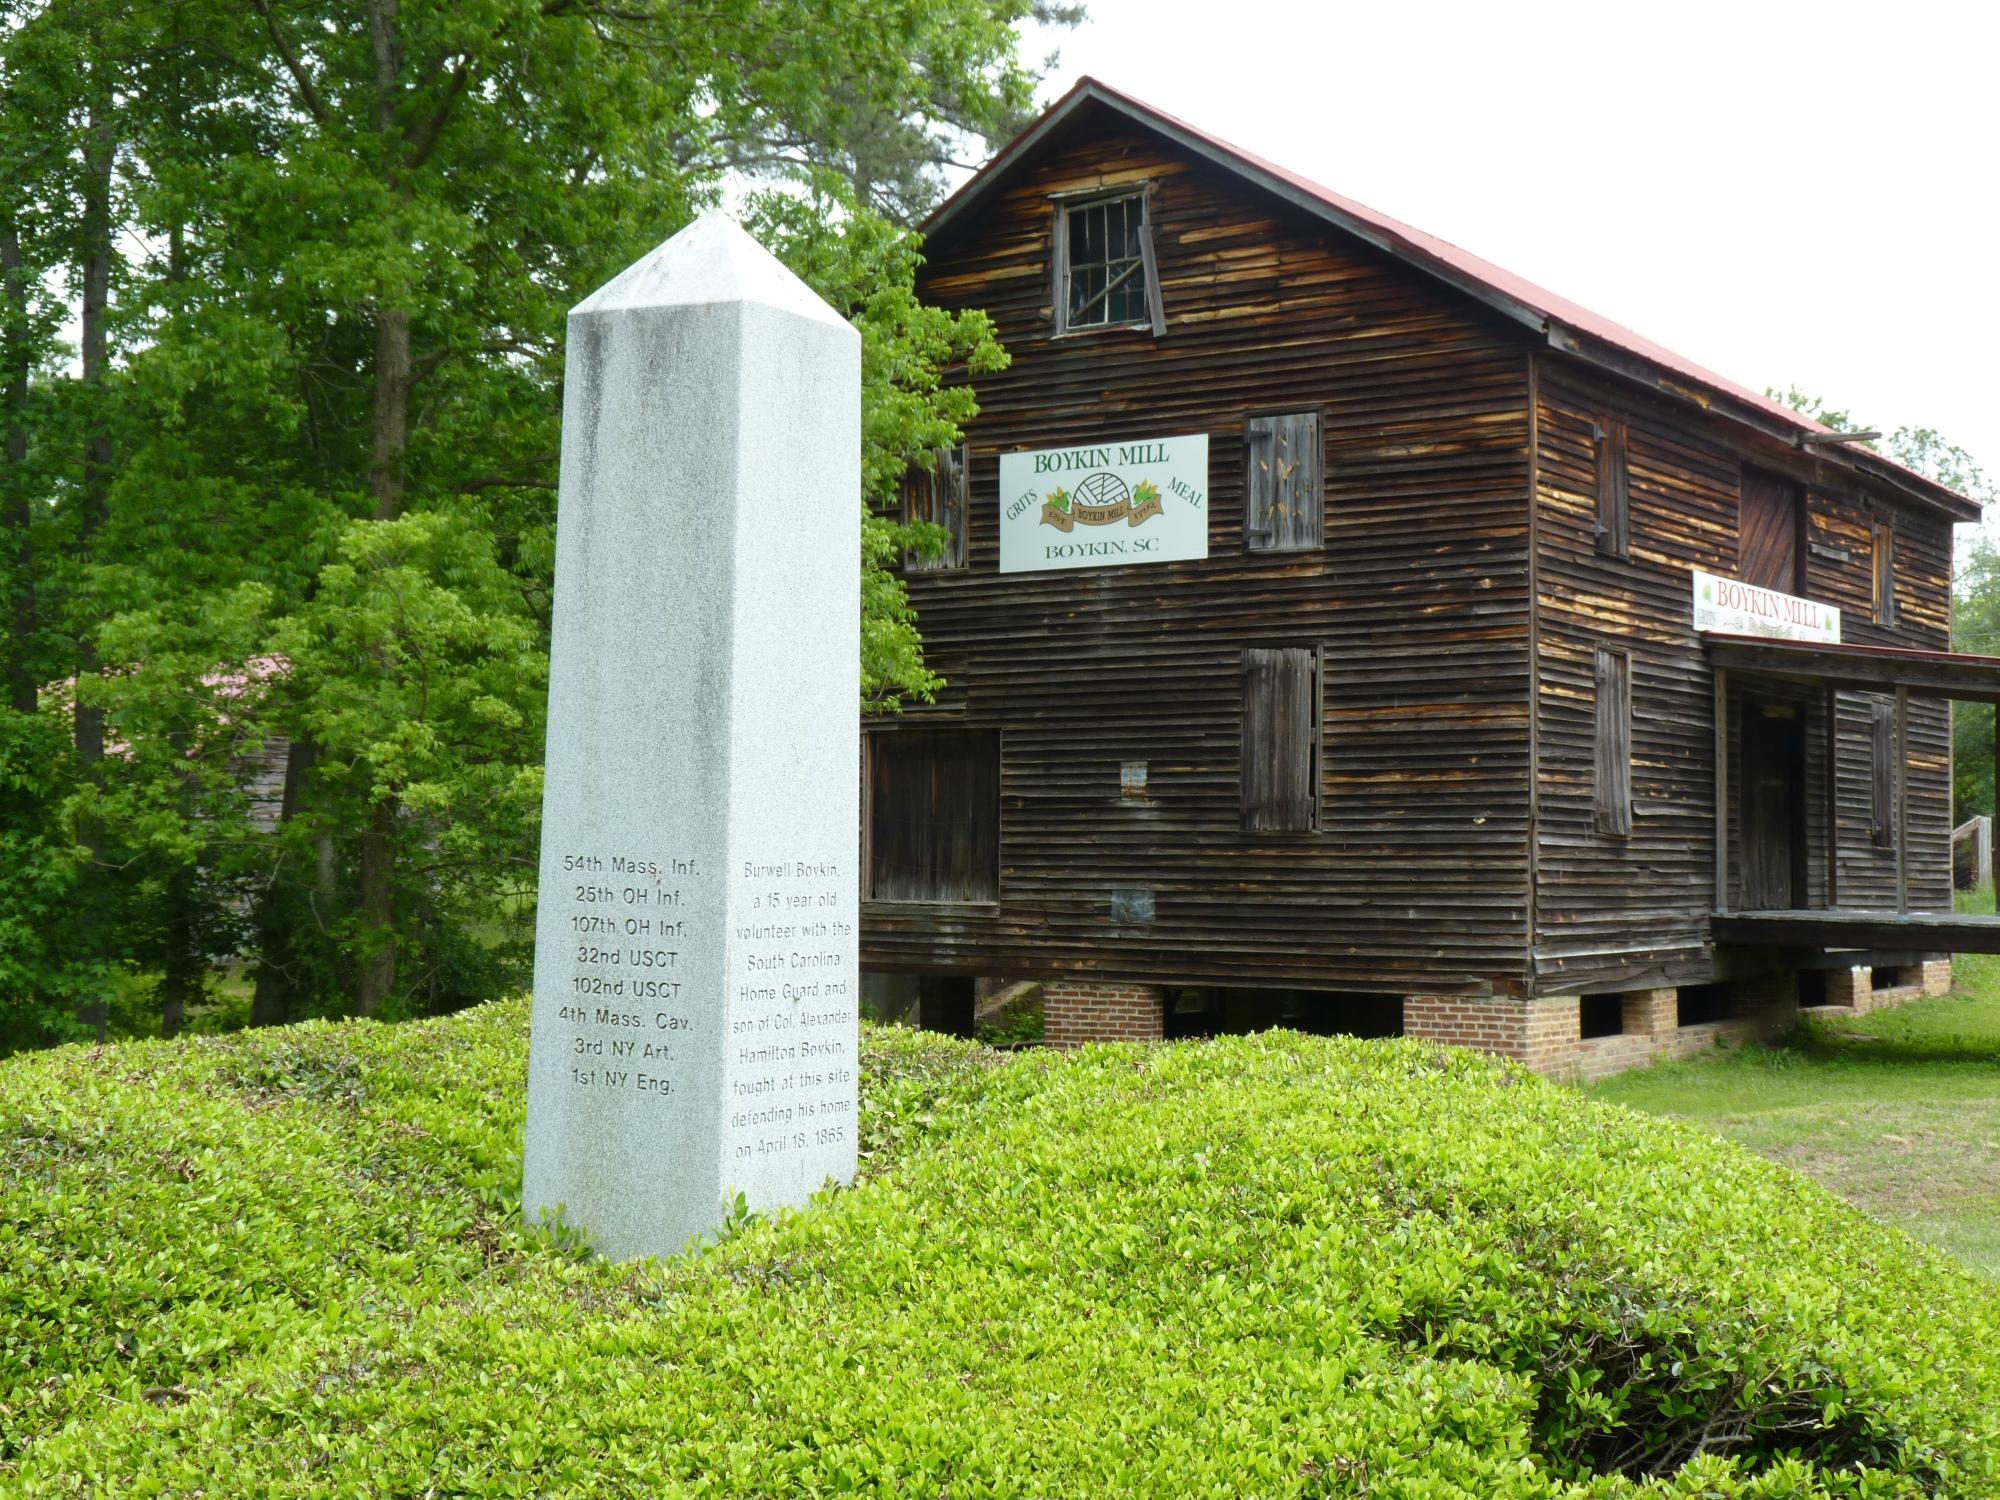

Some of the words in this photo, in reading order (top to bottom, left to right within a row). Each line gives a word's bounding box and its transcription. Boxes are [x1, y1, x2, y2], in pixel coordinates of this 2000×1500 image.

[1034, 448, 1110, 473] BOYKIN
[1119, 444, 1170, 465] MILL
[1168, 476, 1203, 509] MEAL
[1006, 489, 1038, 521] GRITS
[1078, 508, 1105, 521] BOYKIN
[1108, 506, 1123, 520] MILL
[1132, 538, 1159, 552] SC
[1717, 581, 1780, 619] BOYKIN
[1784, 598, 1821, 629] MILL
[563, 855, 602, 872] 54th
[611, 857, 662, 877] Mass.
[672, 858, 701, 875] Inf.
[744, 862, 791, 878] Burwell
[575, 886, 613, 903] 25th
[623, 888, 648, 904] OH
[657, 888, 685, 906] Inf.
[753, 896, 761, 908] a
[767, 892, 780, 908] 15
[786, 895, 812, 910] year
[818, 891, 837, 907] old
[572, 917, 616, 934] 107th
[625, 919, 650, 935] OH
[659, 920, 688, 938] Inf.
[737, 923, 796, 940] volunteer
[802, 922, 827, 936] with
[832, 921, 851, 936] the
[578, 947, 620, 964] 32nd
[630, 950, 678, 968] USCT
[747, 953, 784, 971] South
[791, 951, 840, 968] Carolina
[573, 978, 623, 996] 102nd
[633, 980, 681, 998] USCT
[740, 984, 776, 1002] Home
[782, 982, 819, 1000] Guard
[825, 980, 847, 997] and
[559, 1007, 586, 1023] 4th
[596, 1009, 646, 1027] Mass.
[656, 1012, 694, 1031] Cav.
[733, 1020, 753, 1034] son
[758, 1015, 770, 1031] of
[774, 1014, 795, 1030] Col.
[800, 1008, 851, 1027] Alexander
[574, 1038, 603, 1056] 3rd
[613, 1040, 635, 1057] NY
[643, 1043, 674, 1061] Art.
[739, 1045, 796, 1064] Hamilton
[572, 1069, 596, 1085] 1st
[605, 1071, 628, 1087] NY
[637, 1073, 675, 1095] Eng.
[733, 1076, 775, 1097] fought
[781, 1075, 793, 1090] at
[800, 1072, 822, 1087] this
[828, 1069, 850, 1084] site
[731, 1105, 792, 1128] defending
[798, 1103, 814, 1118] his
[820, 1099, 851, 1114] home
[736, 1145, 751, 1158] on
[758, 1136, 786, 1156] April
